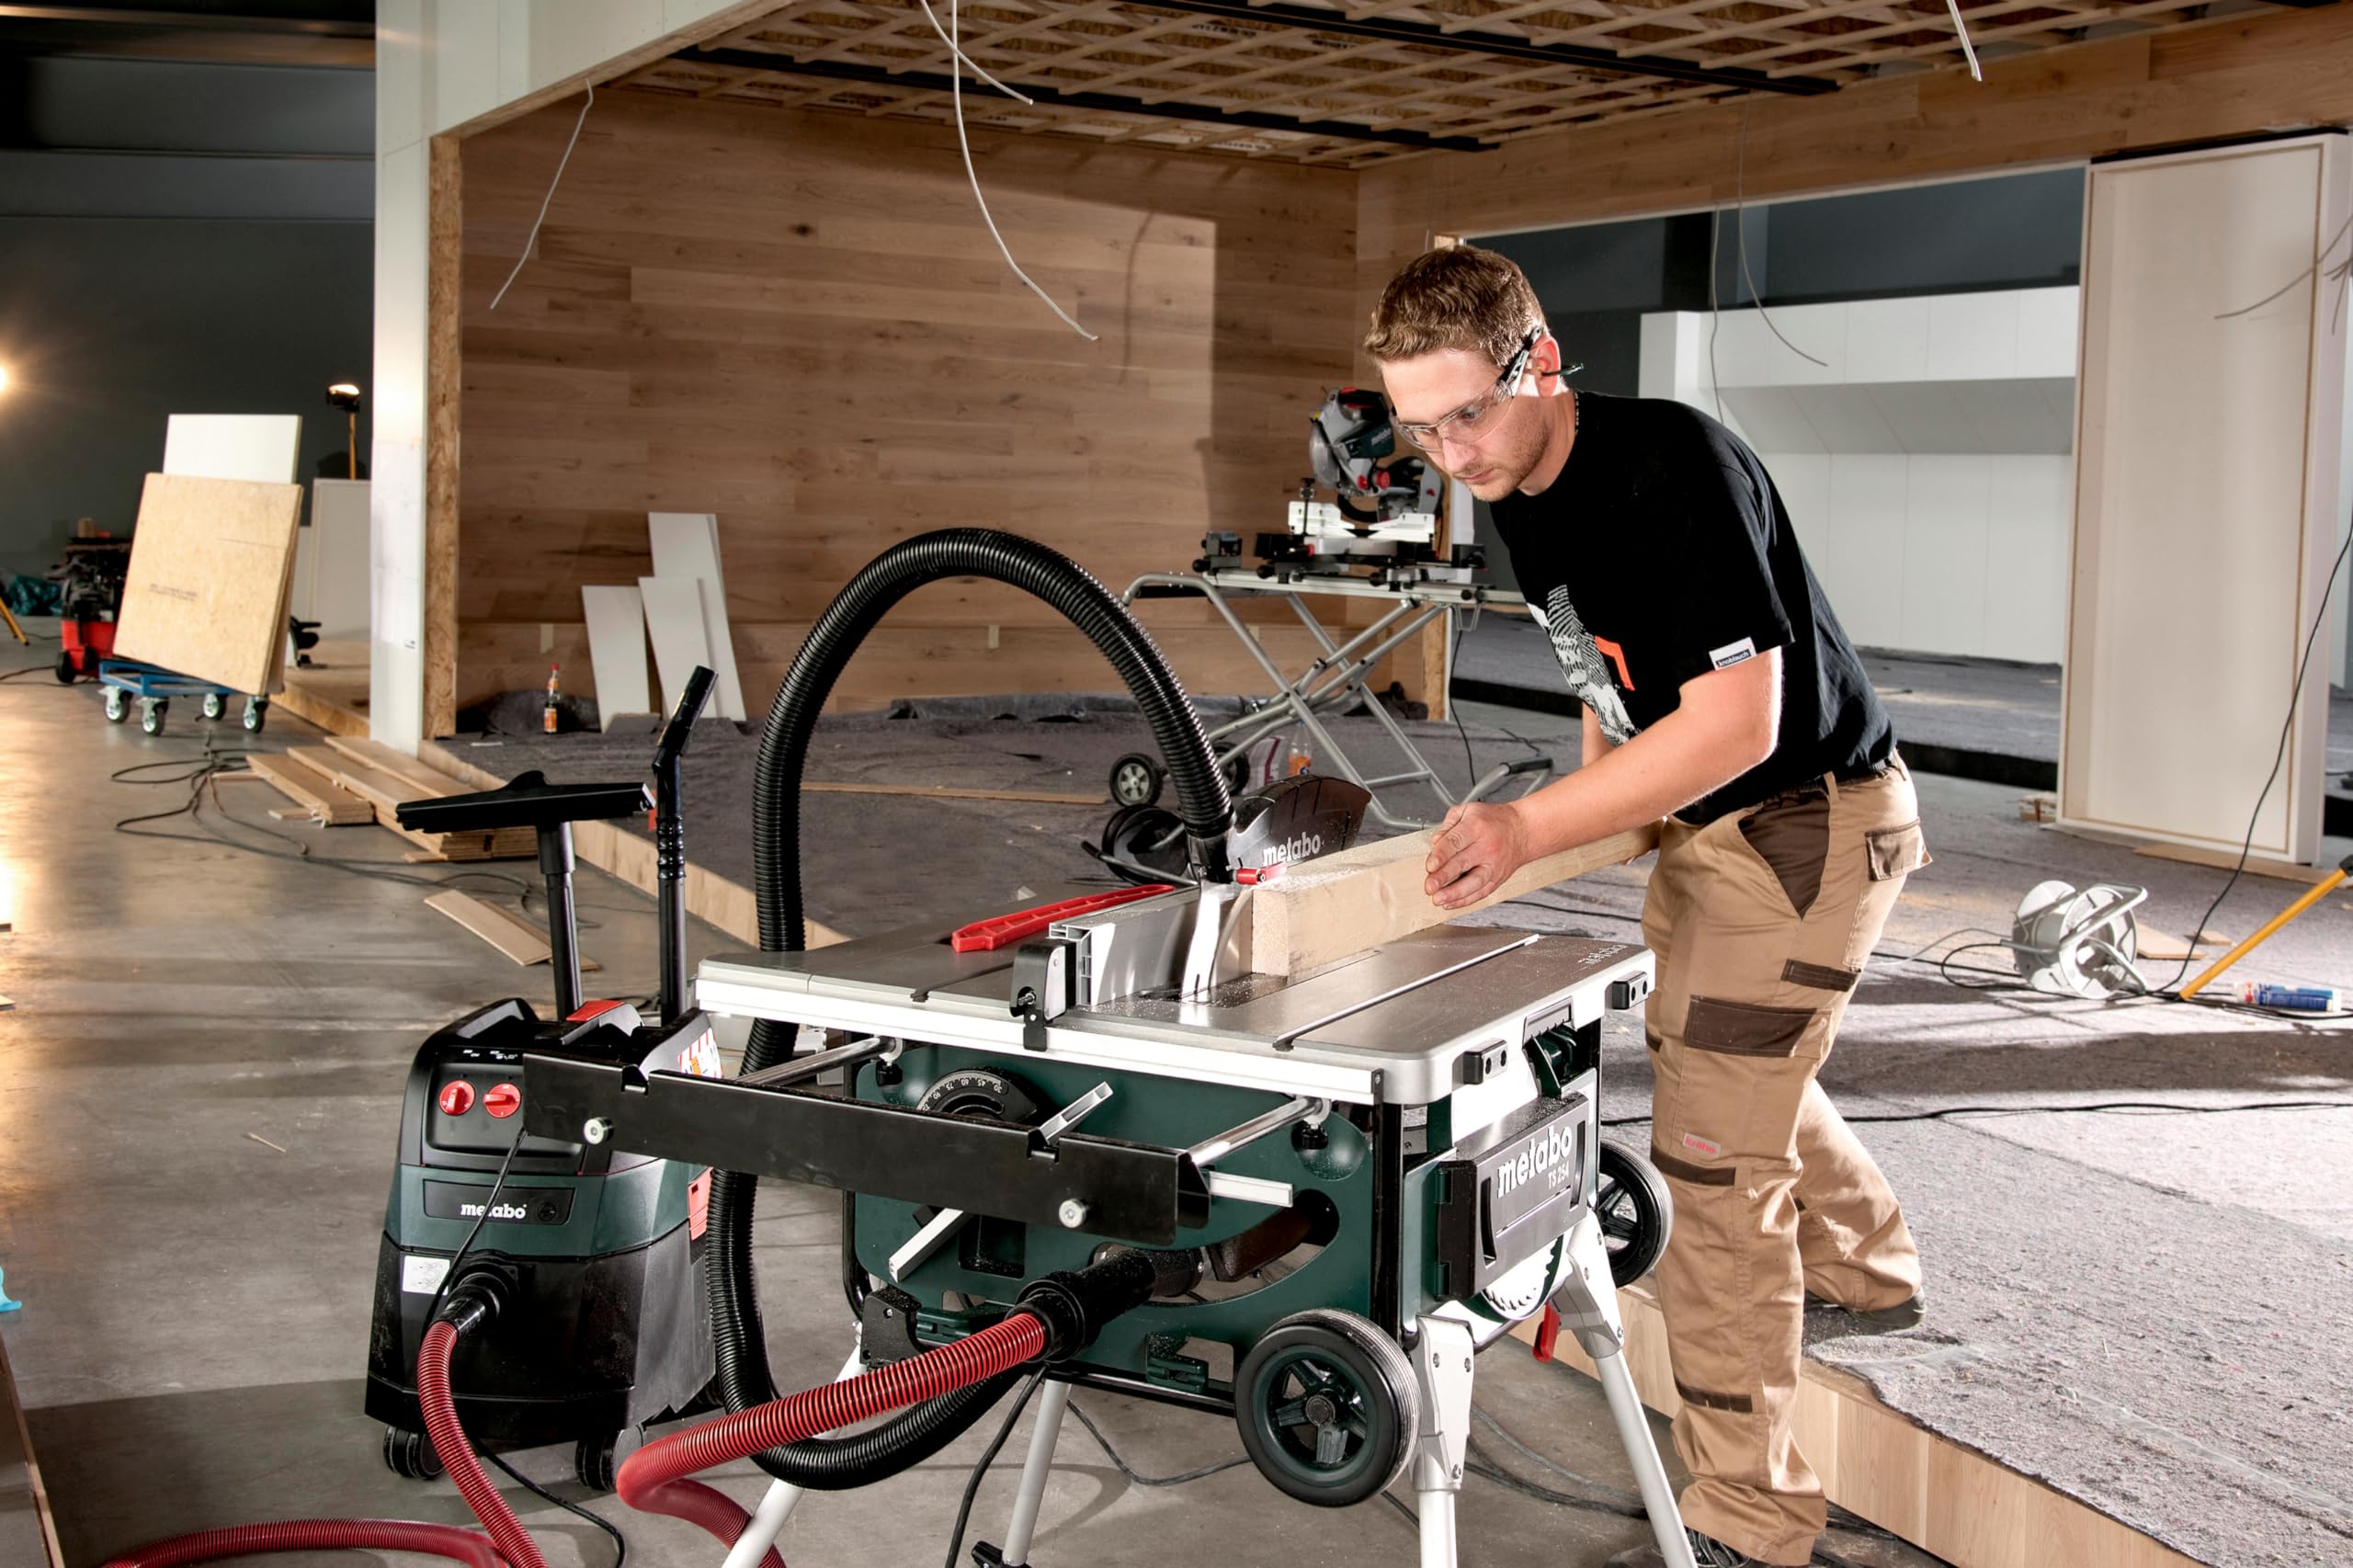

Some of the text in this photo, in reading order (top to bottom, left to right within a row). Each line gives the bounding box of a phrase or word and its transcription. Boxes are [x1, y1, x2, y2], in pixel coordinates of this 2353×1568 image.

[1263, 832, 1321, 867] metabo
[1496, 1124, 1573, 1199] metabo
[1548, 1160, 1570, 1190] TS 254
[460, 1203, 526, 1220] meabo
